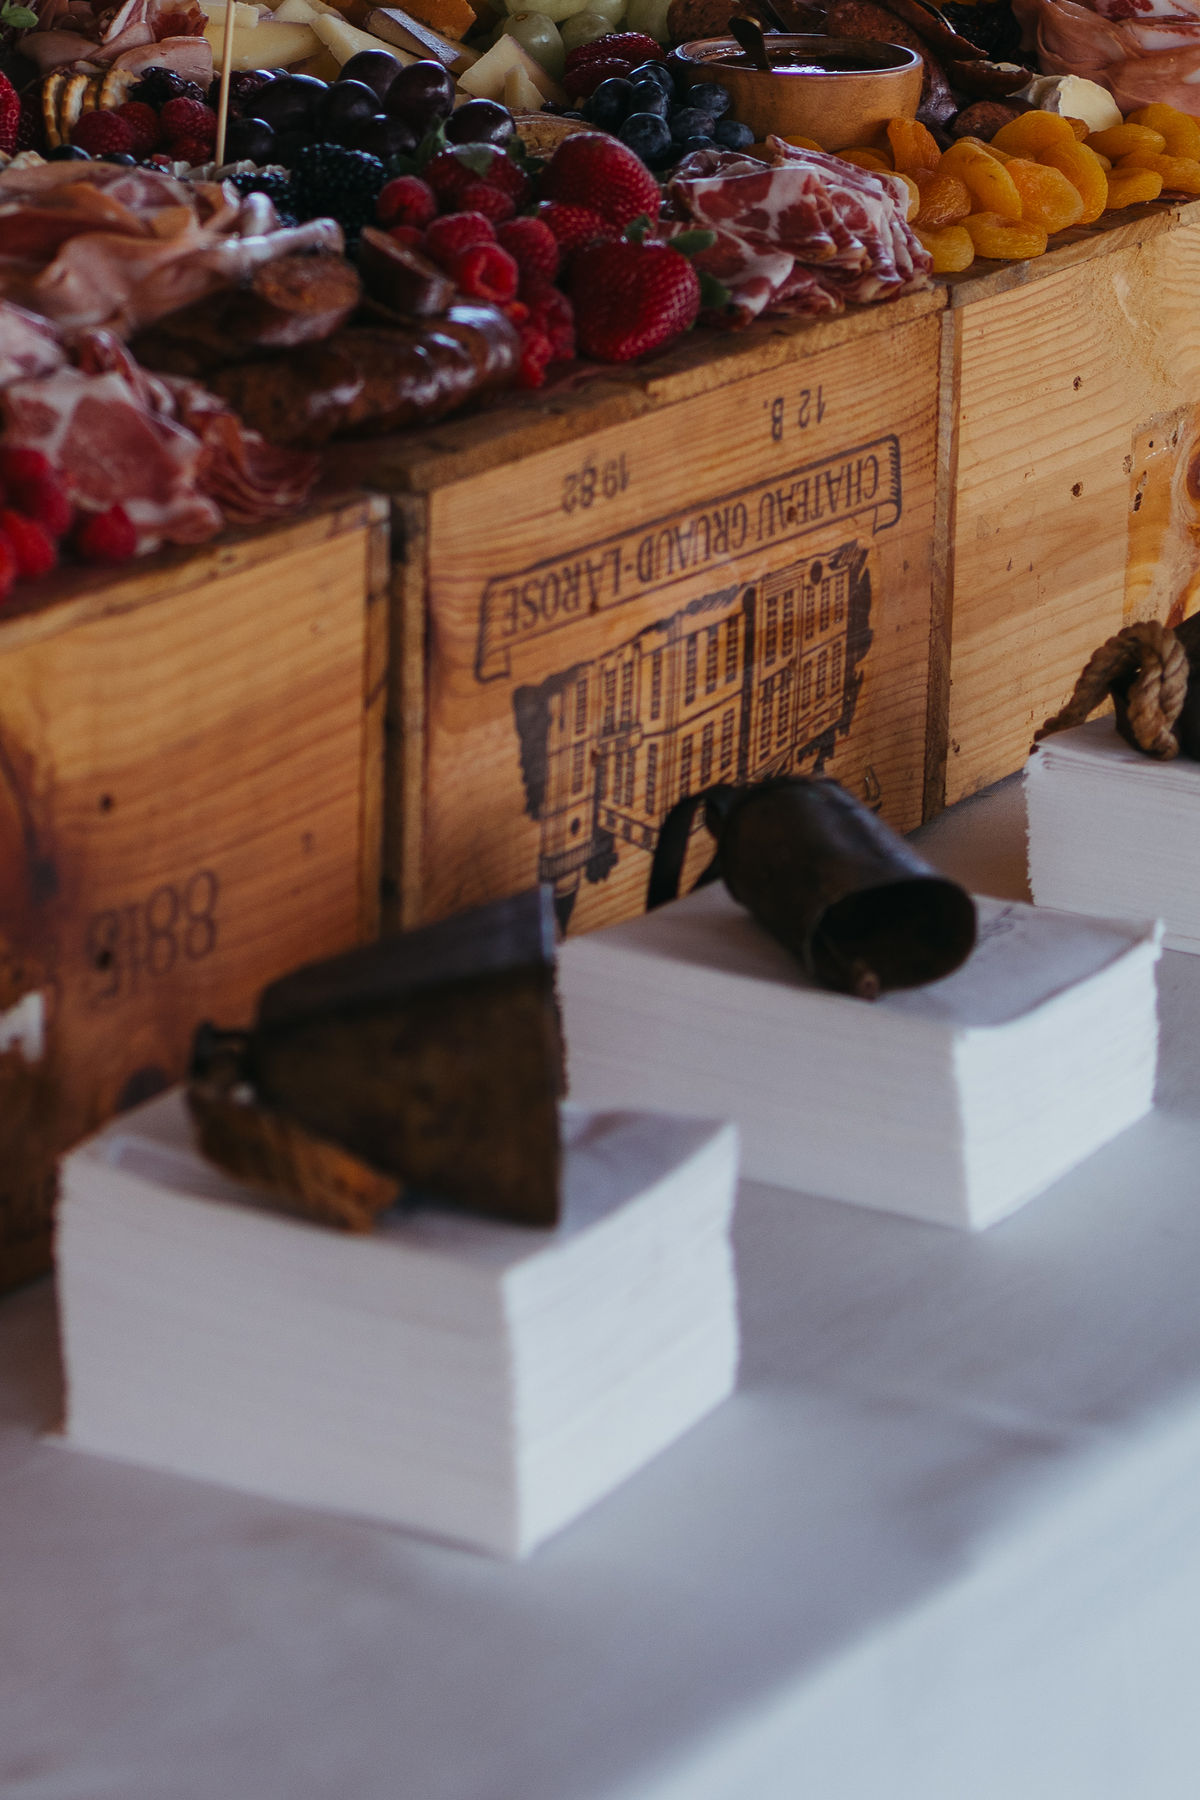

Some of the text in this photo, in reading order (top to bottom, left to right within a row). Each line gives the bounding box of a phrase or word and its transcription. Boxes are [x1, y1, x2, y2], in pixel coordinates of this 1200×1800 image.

[799, 384, 826, 430] 12
[561, 453, 631, 514] 1982
[757, 452, 880, 539] CHATEAU
